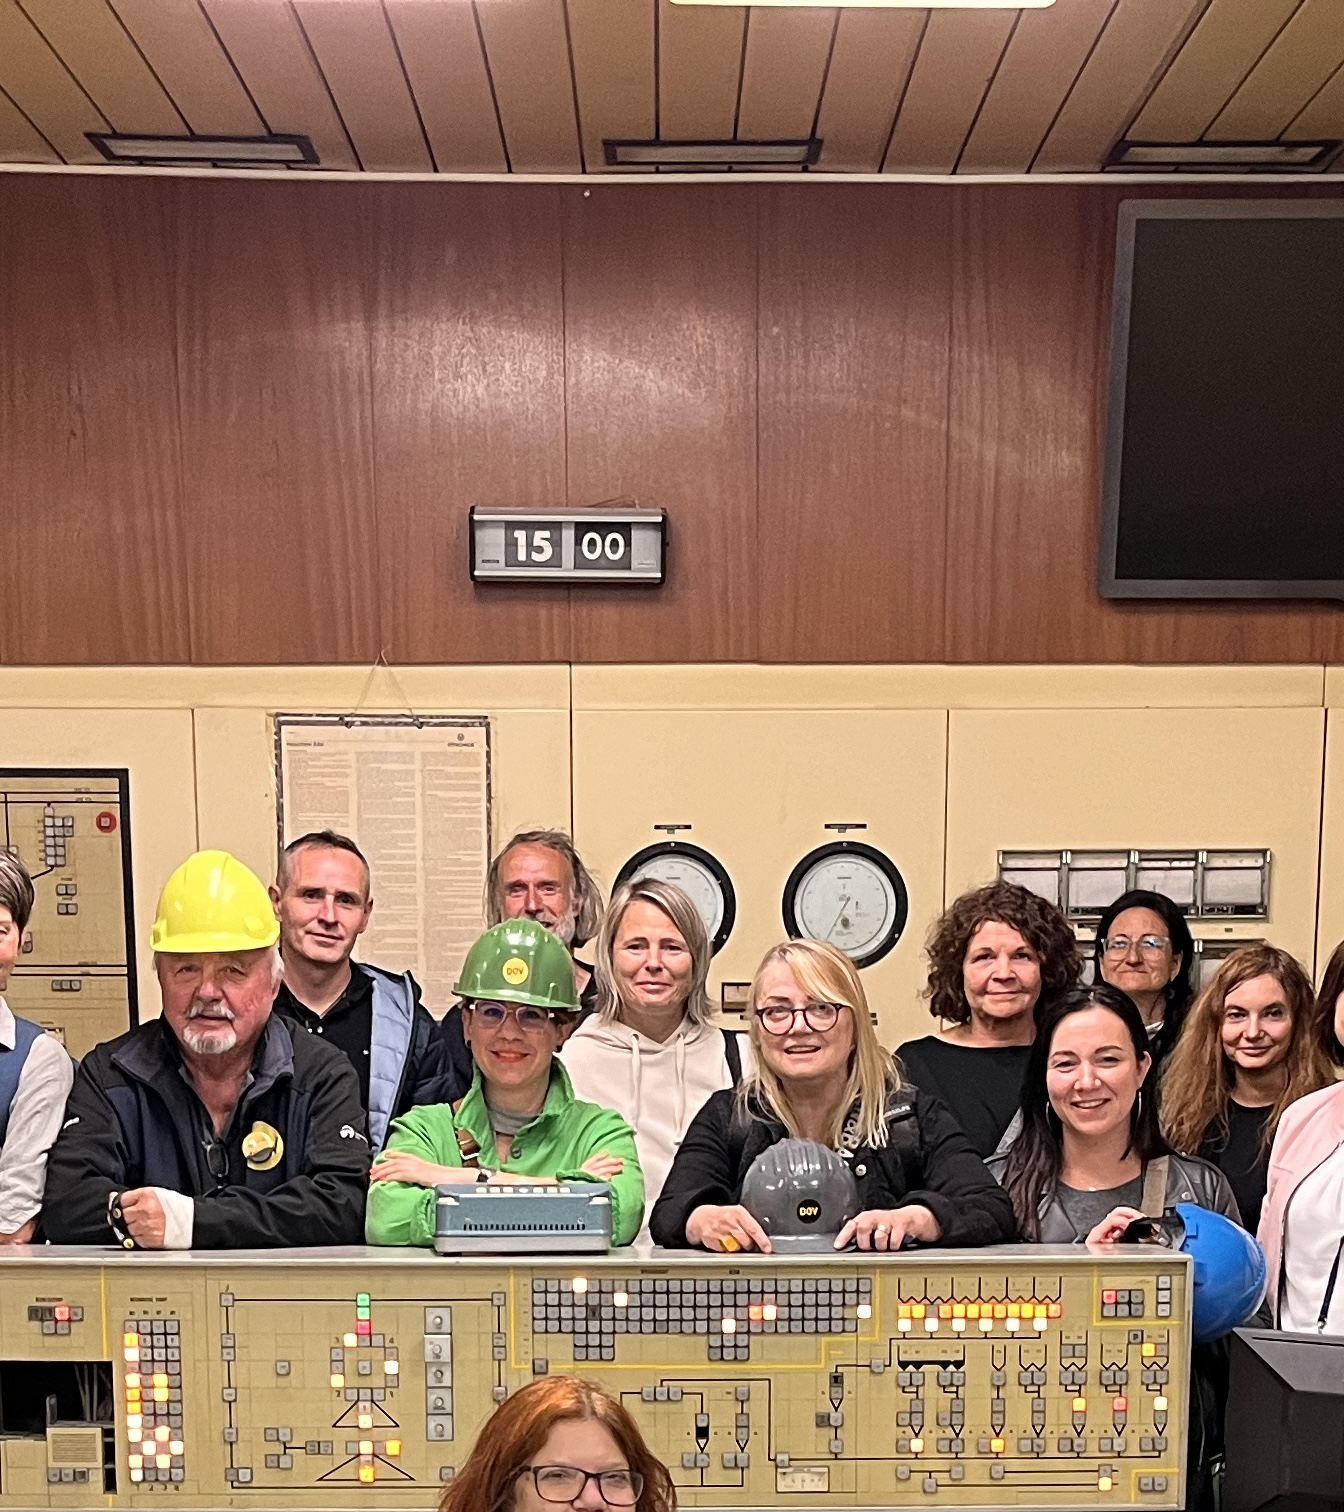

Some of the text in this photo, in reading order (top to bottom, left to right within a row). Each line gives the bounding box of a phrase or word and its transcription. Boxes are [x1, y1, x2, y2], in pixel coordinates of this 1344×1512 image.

[514, 530, 626, 562] 15 00
[799, 1206, 819, 1216] DOV
